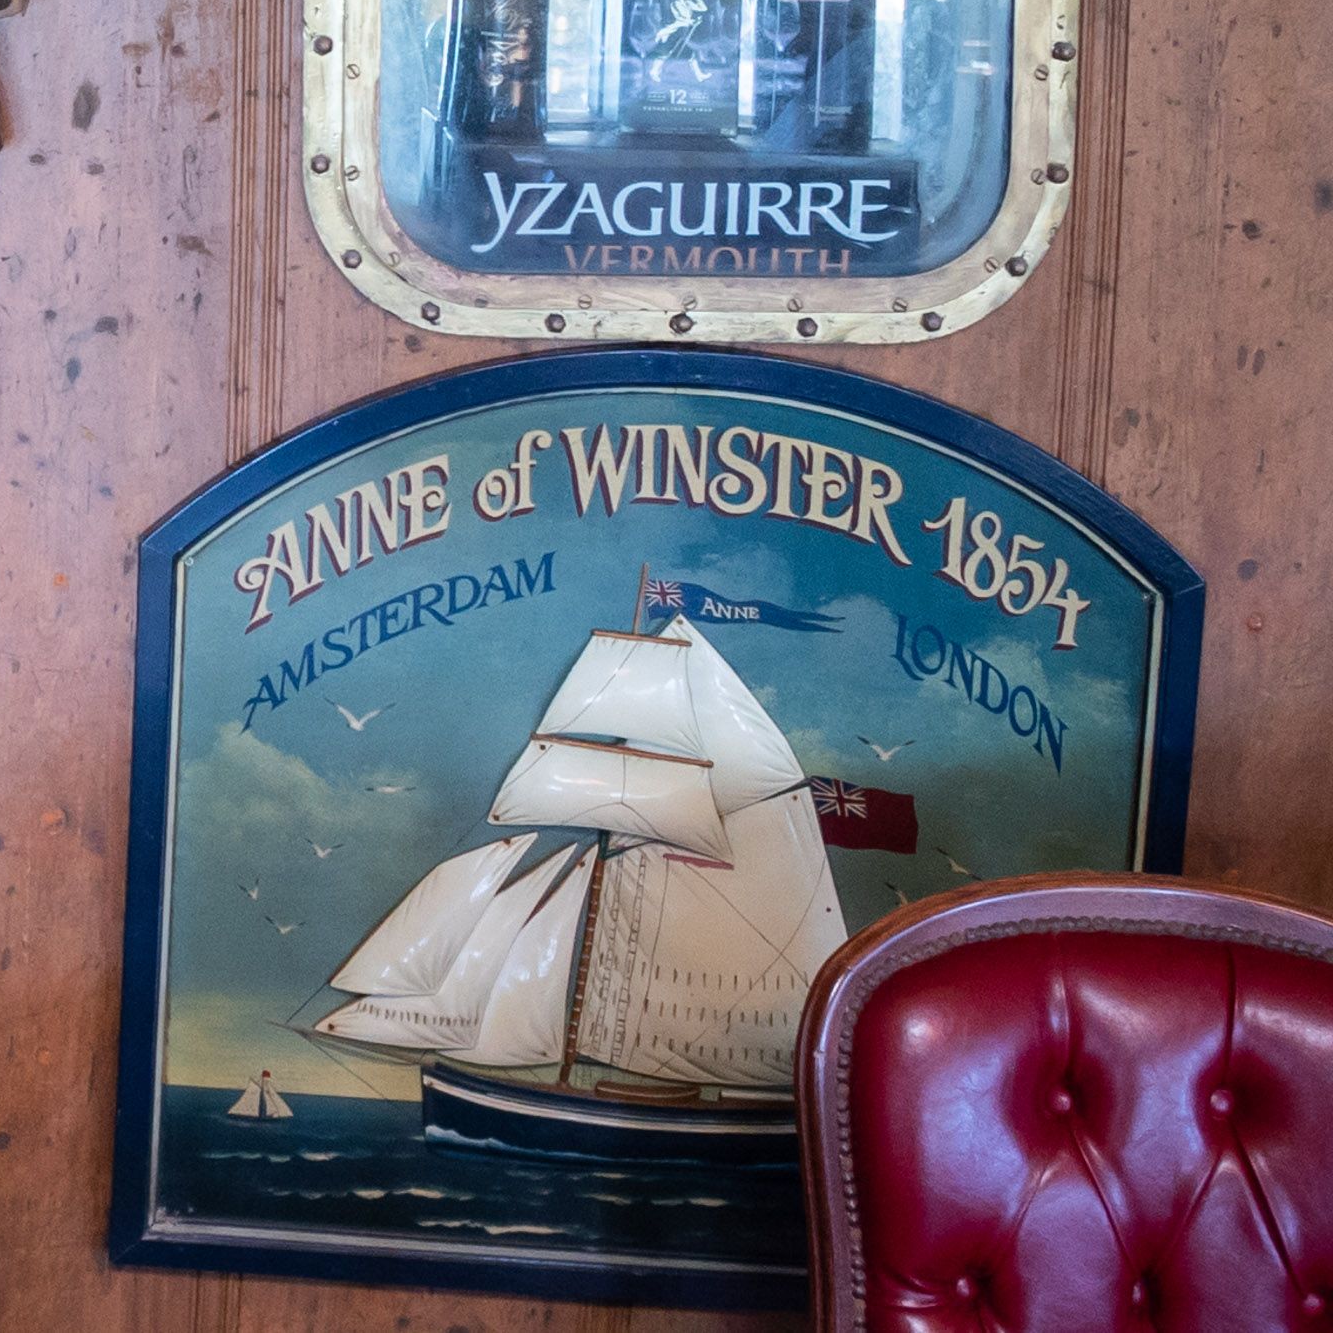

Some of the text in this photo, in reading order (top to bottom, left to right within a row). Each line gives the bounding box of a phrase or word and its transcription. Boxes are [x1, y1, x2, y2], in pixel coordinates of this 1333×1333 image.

[669, 89, 688, 105] 12
[470, 171, 899, 253] YZAGUIRRE
[563, 244, 852, 275] VERMOUTH
[234, 423, 1092, 651] ANNE of WINSTER 1854
[240, 550, 558, 734] AMSTERDAM
[890, 614, 1070, 778] LONDON
